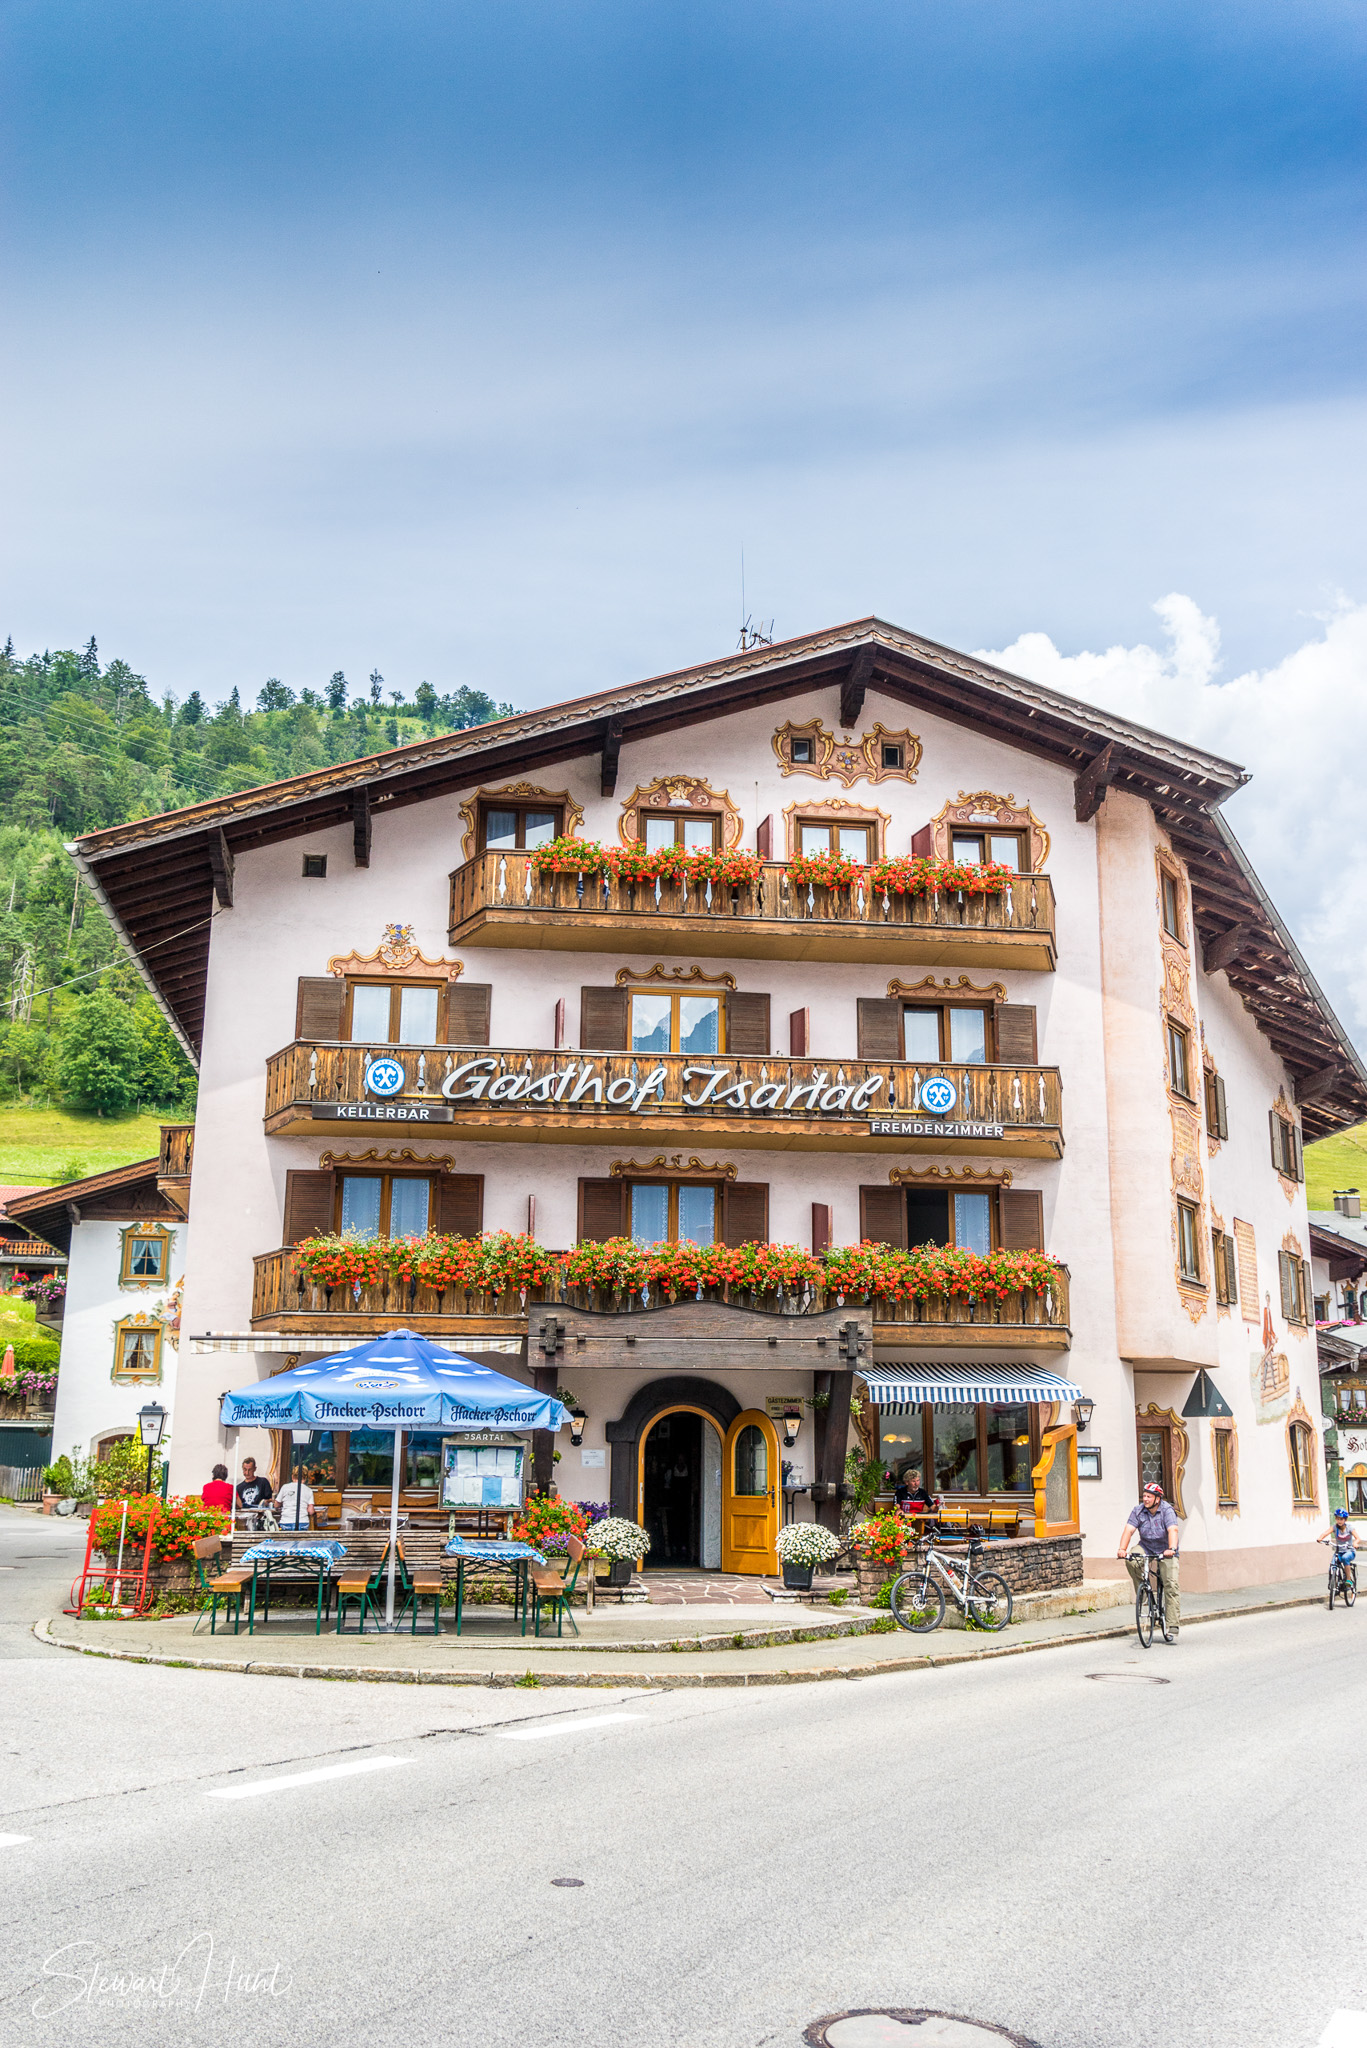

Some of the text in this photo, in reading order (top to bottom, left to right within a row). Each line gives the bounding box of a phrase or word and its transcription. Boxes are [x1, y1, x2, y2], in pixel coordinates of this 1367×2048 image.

[441, 1058, 668, 1112] Gasthof
[337, 1106, 430, 1119] KELLERBAR
[871, 1121, 1004, 1137] FREMDENZIMMER
[231, 1403, 293, 1422] Hacker-Pschorr
[315, 1402, 425, 1421] Hacker-Pschorr
[450, 1404, 538, 1425] Hacker-Pschorr
